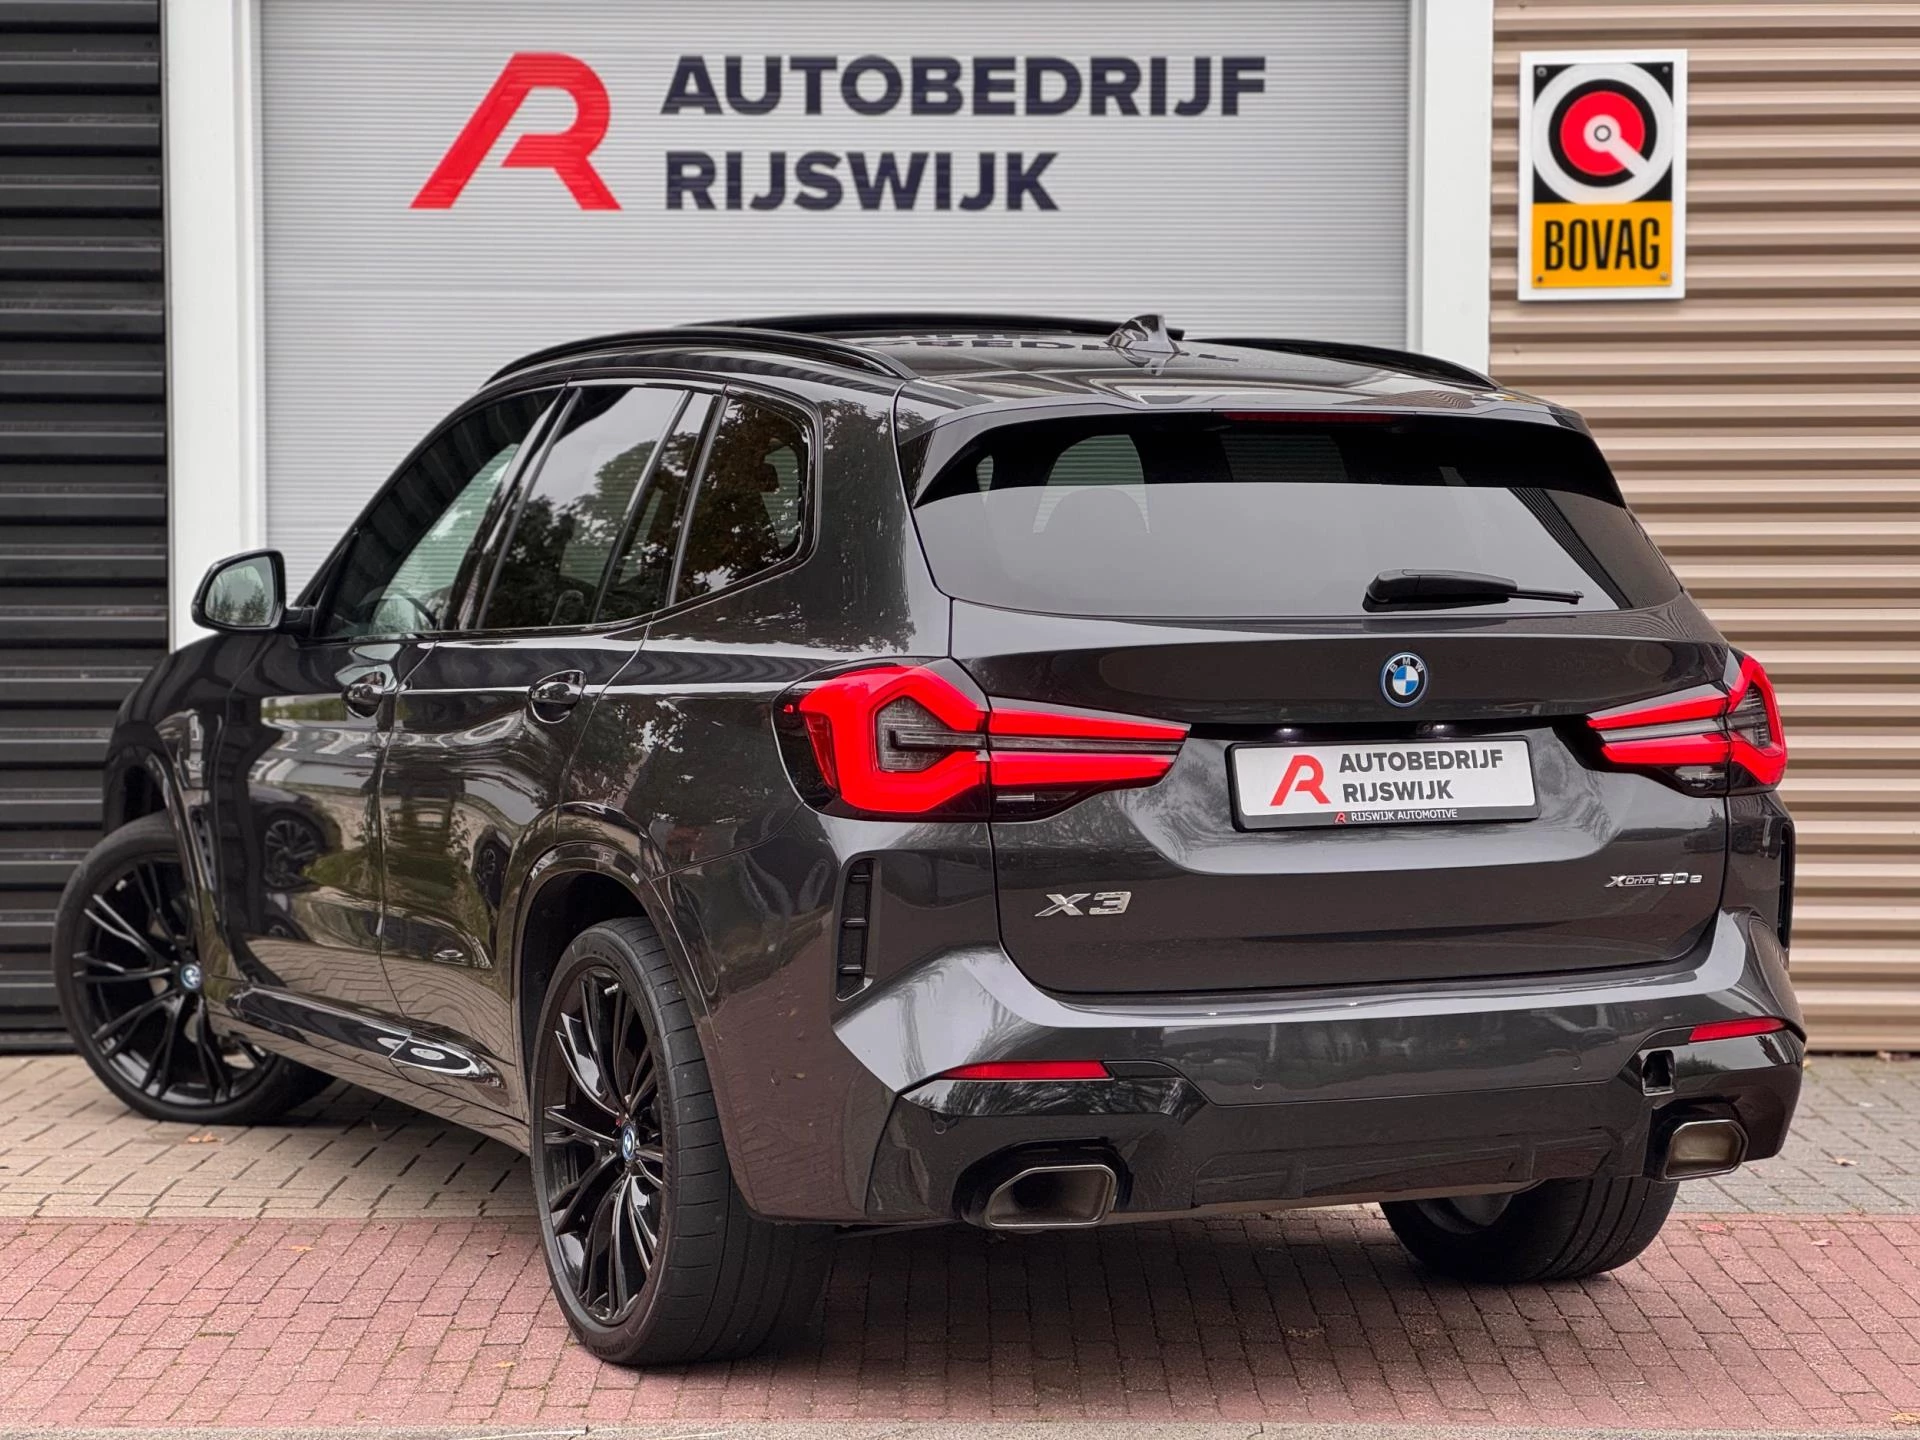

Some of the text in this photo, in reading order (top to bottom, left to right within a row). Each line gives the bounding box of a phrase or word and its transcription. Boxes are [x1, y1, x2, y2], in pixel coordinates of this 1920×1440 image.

[661, 55, 1266, 117] AUTOBEDRIJF
[666, 151, 1059, 211] RIJSWIJK
[1544, 218, 1660, 272] BOVAG
[1389, 657, 1425, 673] BMW
[1339, 749, 1503, 773] AUTOBEDRIJF
[1343, 779, 1454, 802] RIJSWIJK
[1351, 811, 1395, 822] RIJSWIJK
[1397, 808, 1458, 820] AUTOMOTIVE
[1034, 891, 1131, 917] X3
